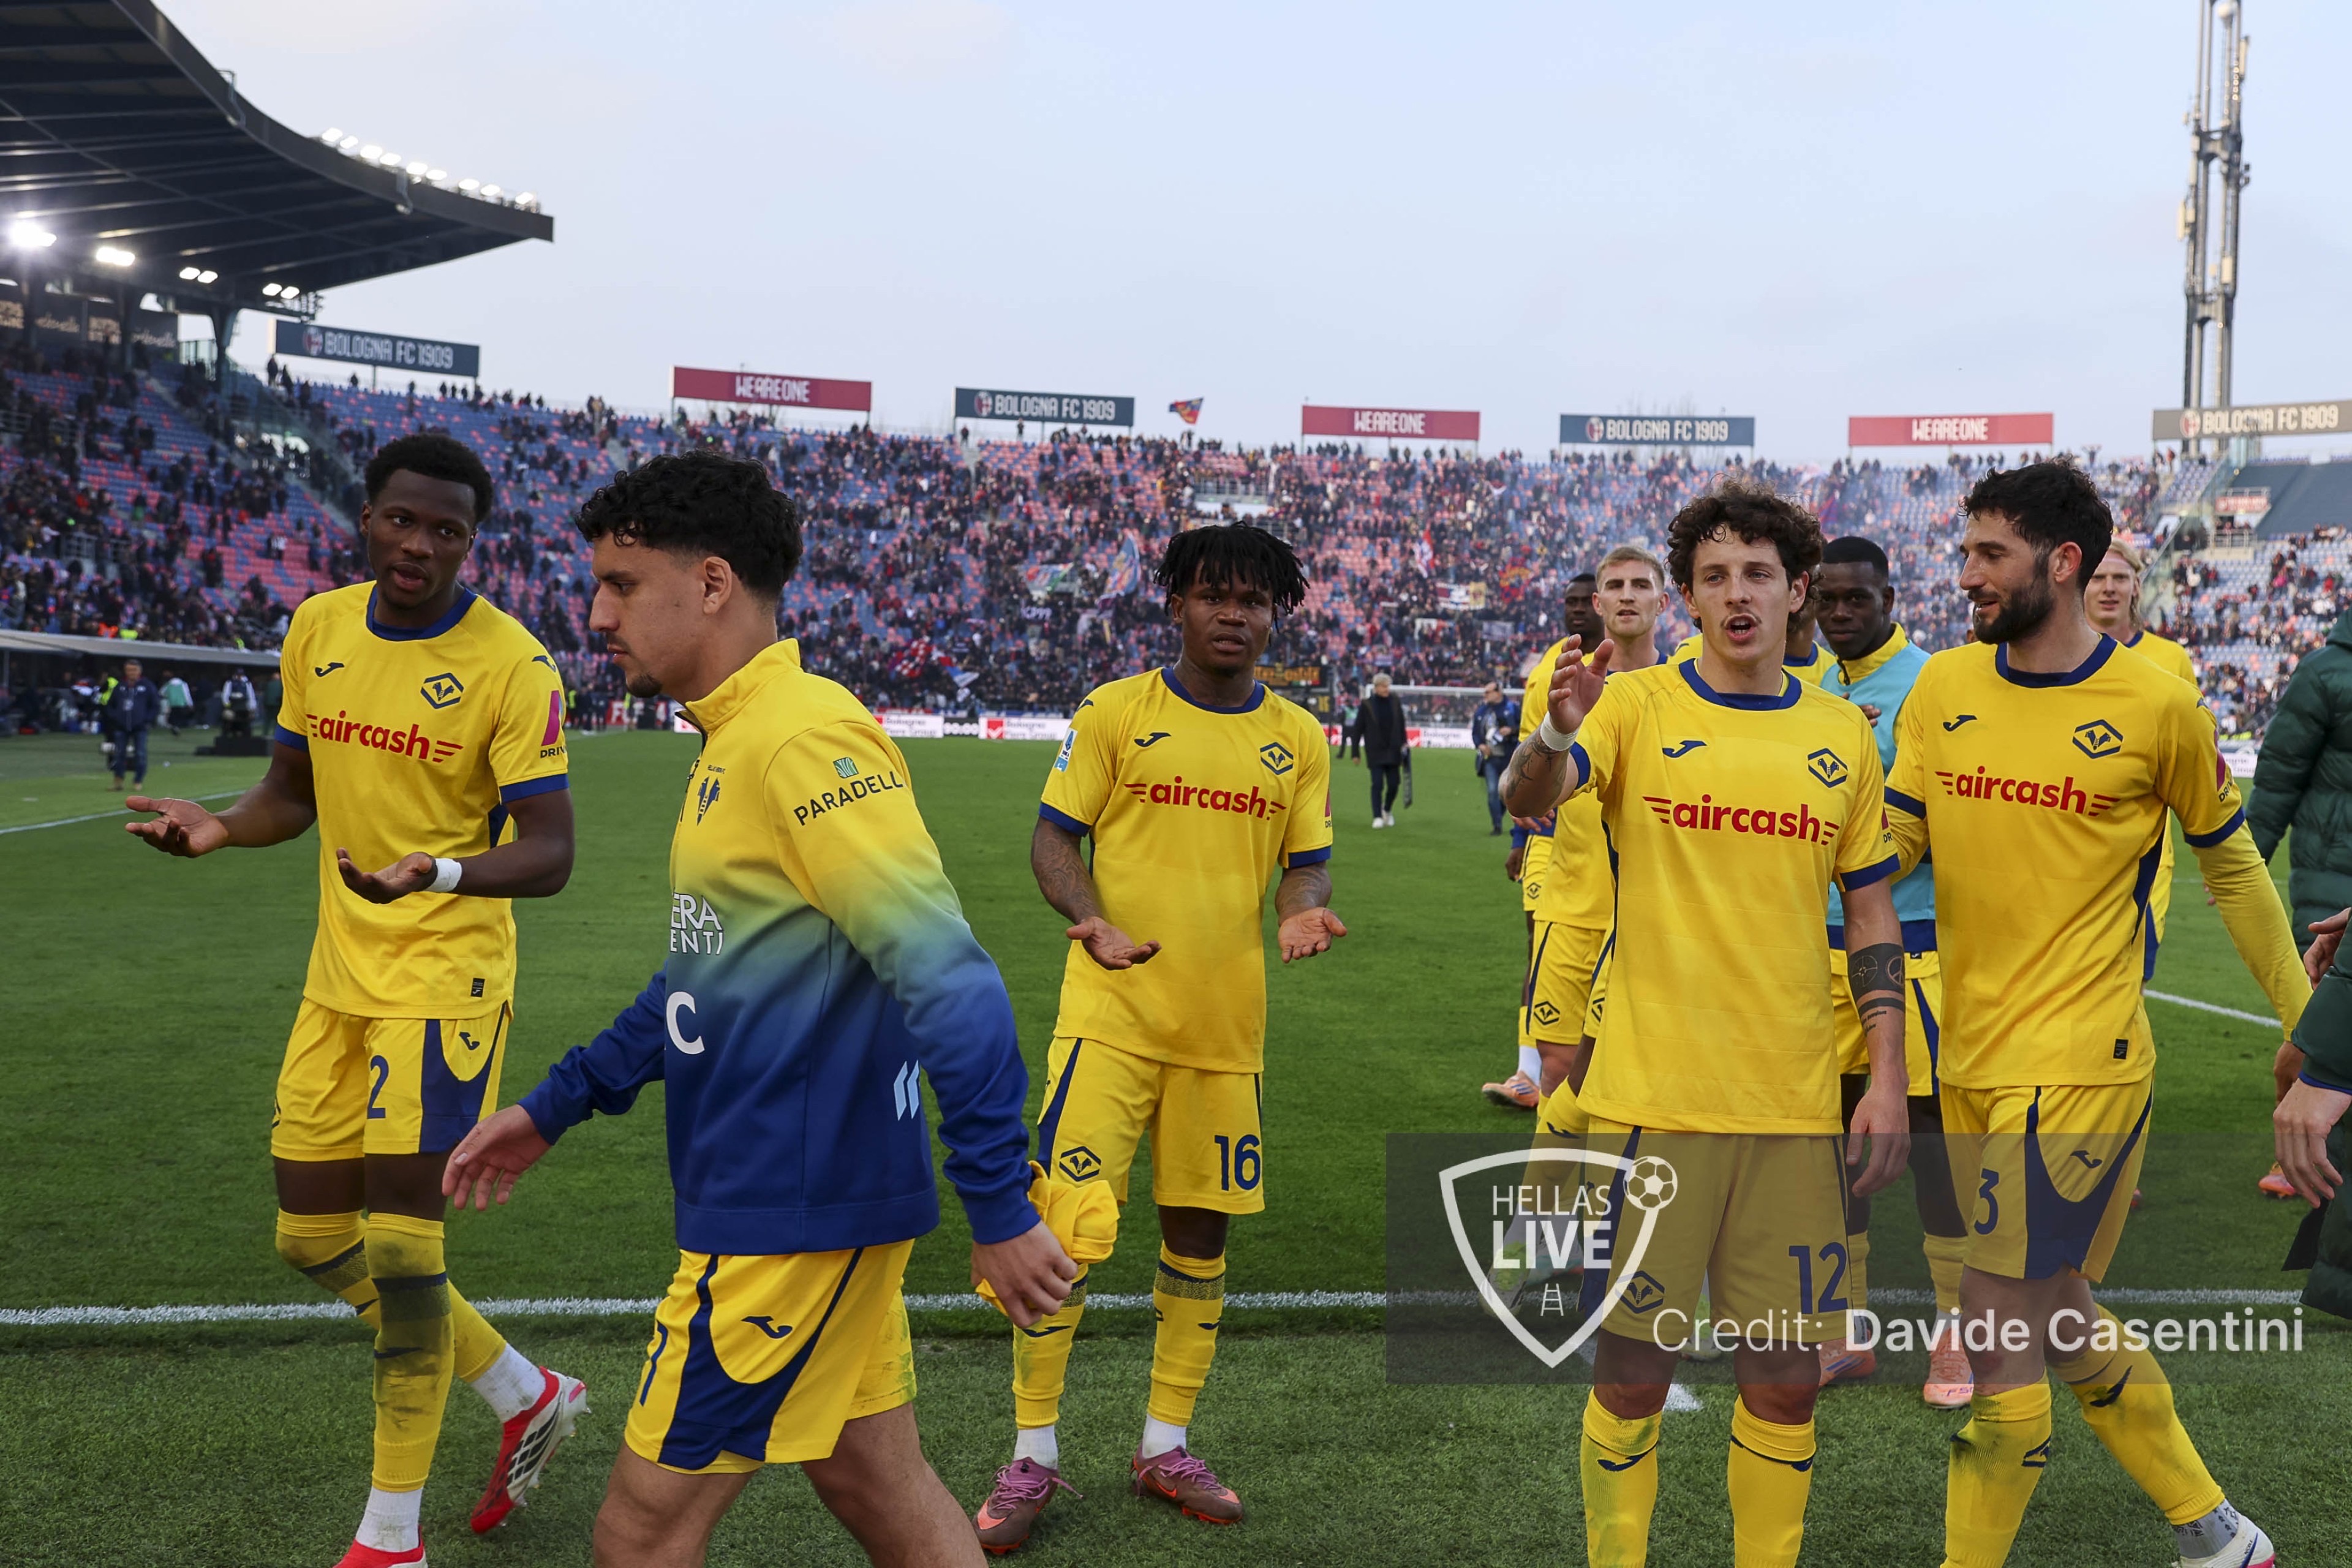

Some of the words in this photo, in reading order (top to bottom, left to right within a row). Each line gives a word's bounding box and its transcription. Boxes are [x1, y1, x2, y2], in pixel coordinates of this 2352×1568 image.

[324, 331, 393, 362] BOLOGNA
[396, 339, 416, 364] FC
[418, 344, 453, 369] 1909
[995, 394, 1058, 418] BOLOGNA
[1061, 398, 1080, 419] FC
[1083, 399, 1116, 421] 1909
[1606, 419, 1670, 441] BOLOGNA
[1674, 420, 1692, 441] FC
[1695, 420, 1728, 442] 1909
[2277, 407, 2297, 431] FC
[2301, 404, 2339, 429] 1909
[319, 710, 430, 761] aircash
[1150, 775, 1267, 819] aircash
[1956, 766, 2087, 814] aircash
[1673, 794, 1821, 843] aircash
[367, 1055, 389, 1119] 2
[1215, 1134, 1261, 1191] 16
[1973, 1167, 1999, 1235] 3
[1789, 1242, 1849, 1314] 12
